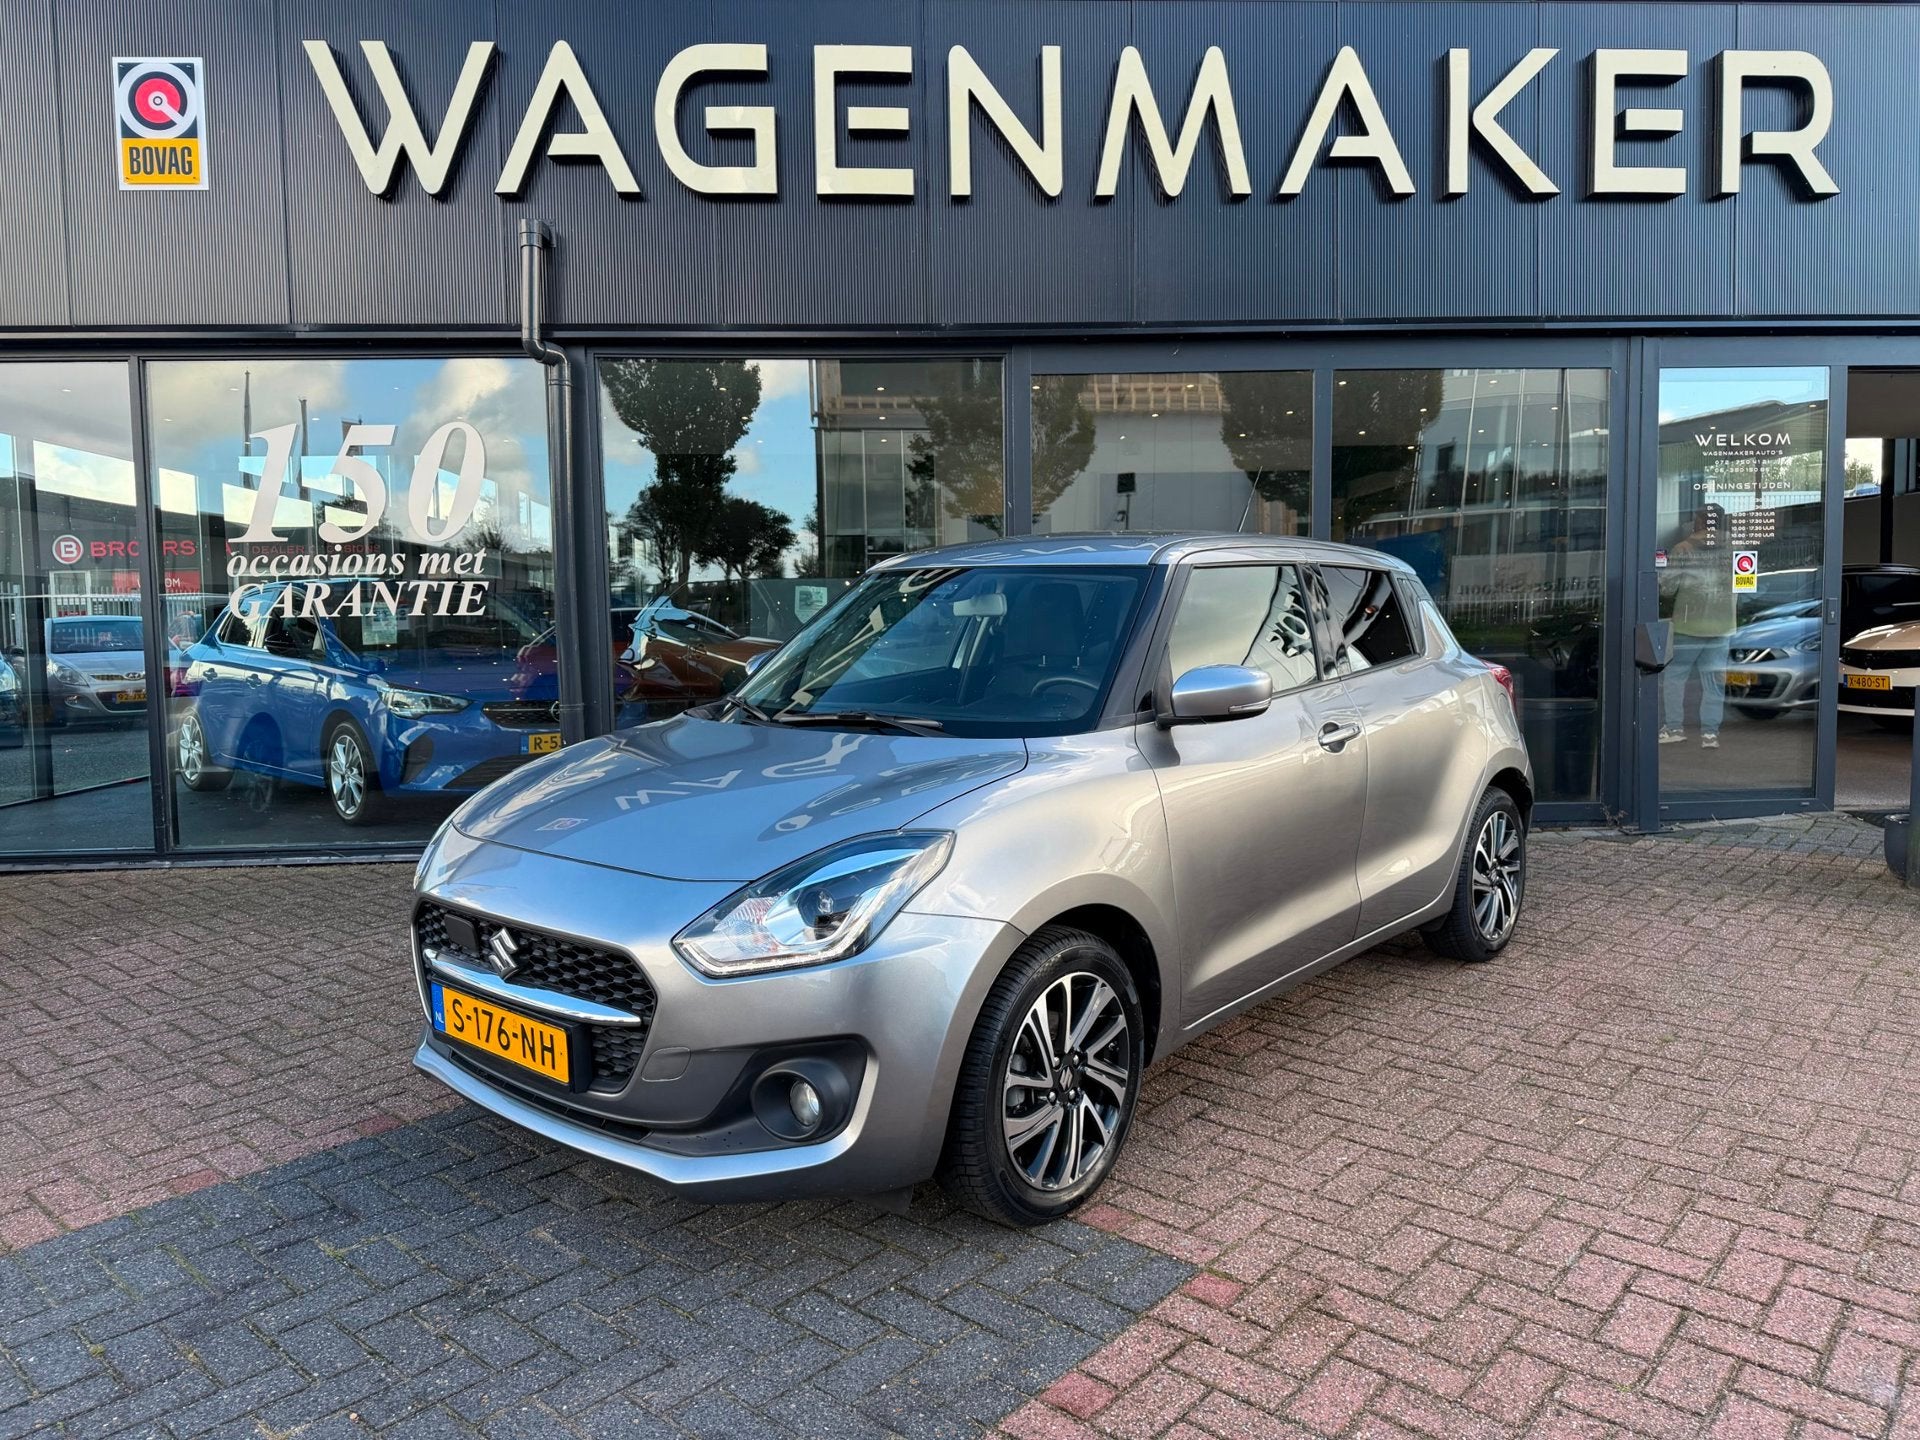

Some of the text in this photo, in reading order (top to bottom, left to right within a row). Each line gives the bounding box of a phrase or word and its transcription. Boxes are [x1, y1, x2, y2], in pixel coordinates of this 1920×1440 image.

[303, 40, 1840, 197] WAGENMAKER
[128, 146, 193, 175] BOVAG
[1694, 433, 1791, 447] WELKOM
[228, 422, 485, 543] 150
[1693, 481, 1791, 491] OPNINGSTIJDEN
[227, 545, 406, 578] occasions
[418, 547, 487, 576] met
[1735, 576, 1754, 586] BOVAG
[229, 580, 490, 620] GARANTIE
[1849, 675, 1887, 688] X-480-ST
[435, 998, 556, 1071] NL S-176-NH
